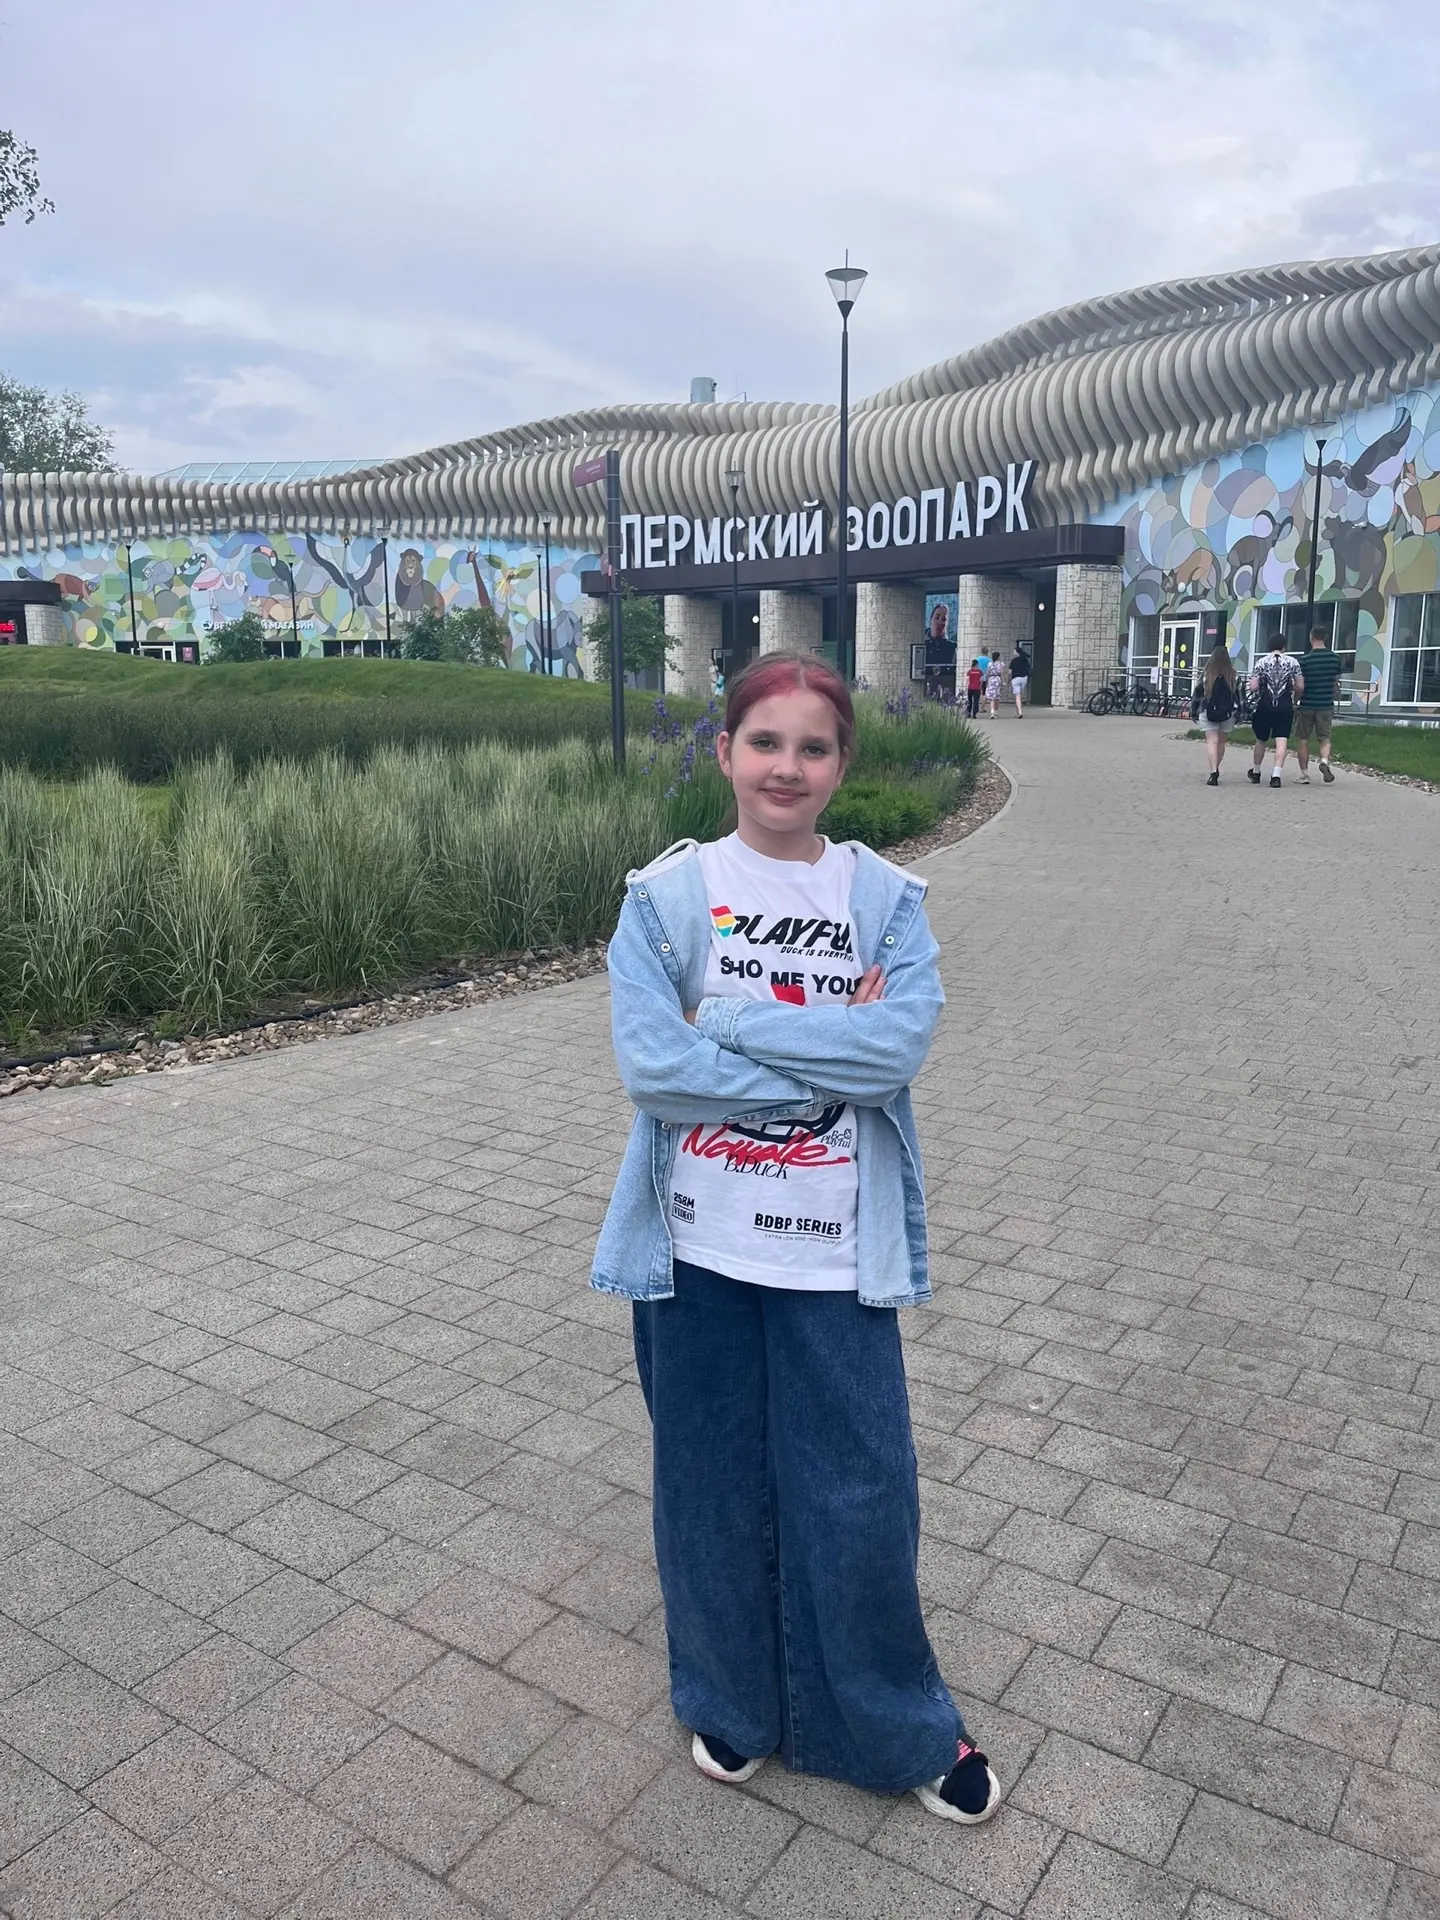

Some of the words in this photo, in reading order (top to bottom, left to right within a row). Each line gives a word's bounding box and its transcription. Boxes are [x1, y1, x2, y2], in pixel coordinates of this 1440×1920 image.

[620, 500, 824, 570] ПЕРМСКИЙ
[846, 459, 1038, 552] ЗООПАРК
[780, 945, 804, 956] DUCK
[805, 949, 816, 957] IS
[770, 971, 806, 988] ME
[724, 1153, 790, 1180] B.Duck
[754, 1212, 792, 1231] BDBP
[796, 1217, 842, 1236] SERIES
